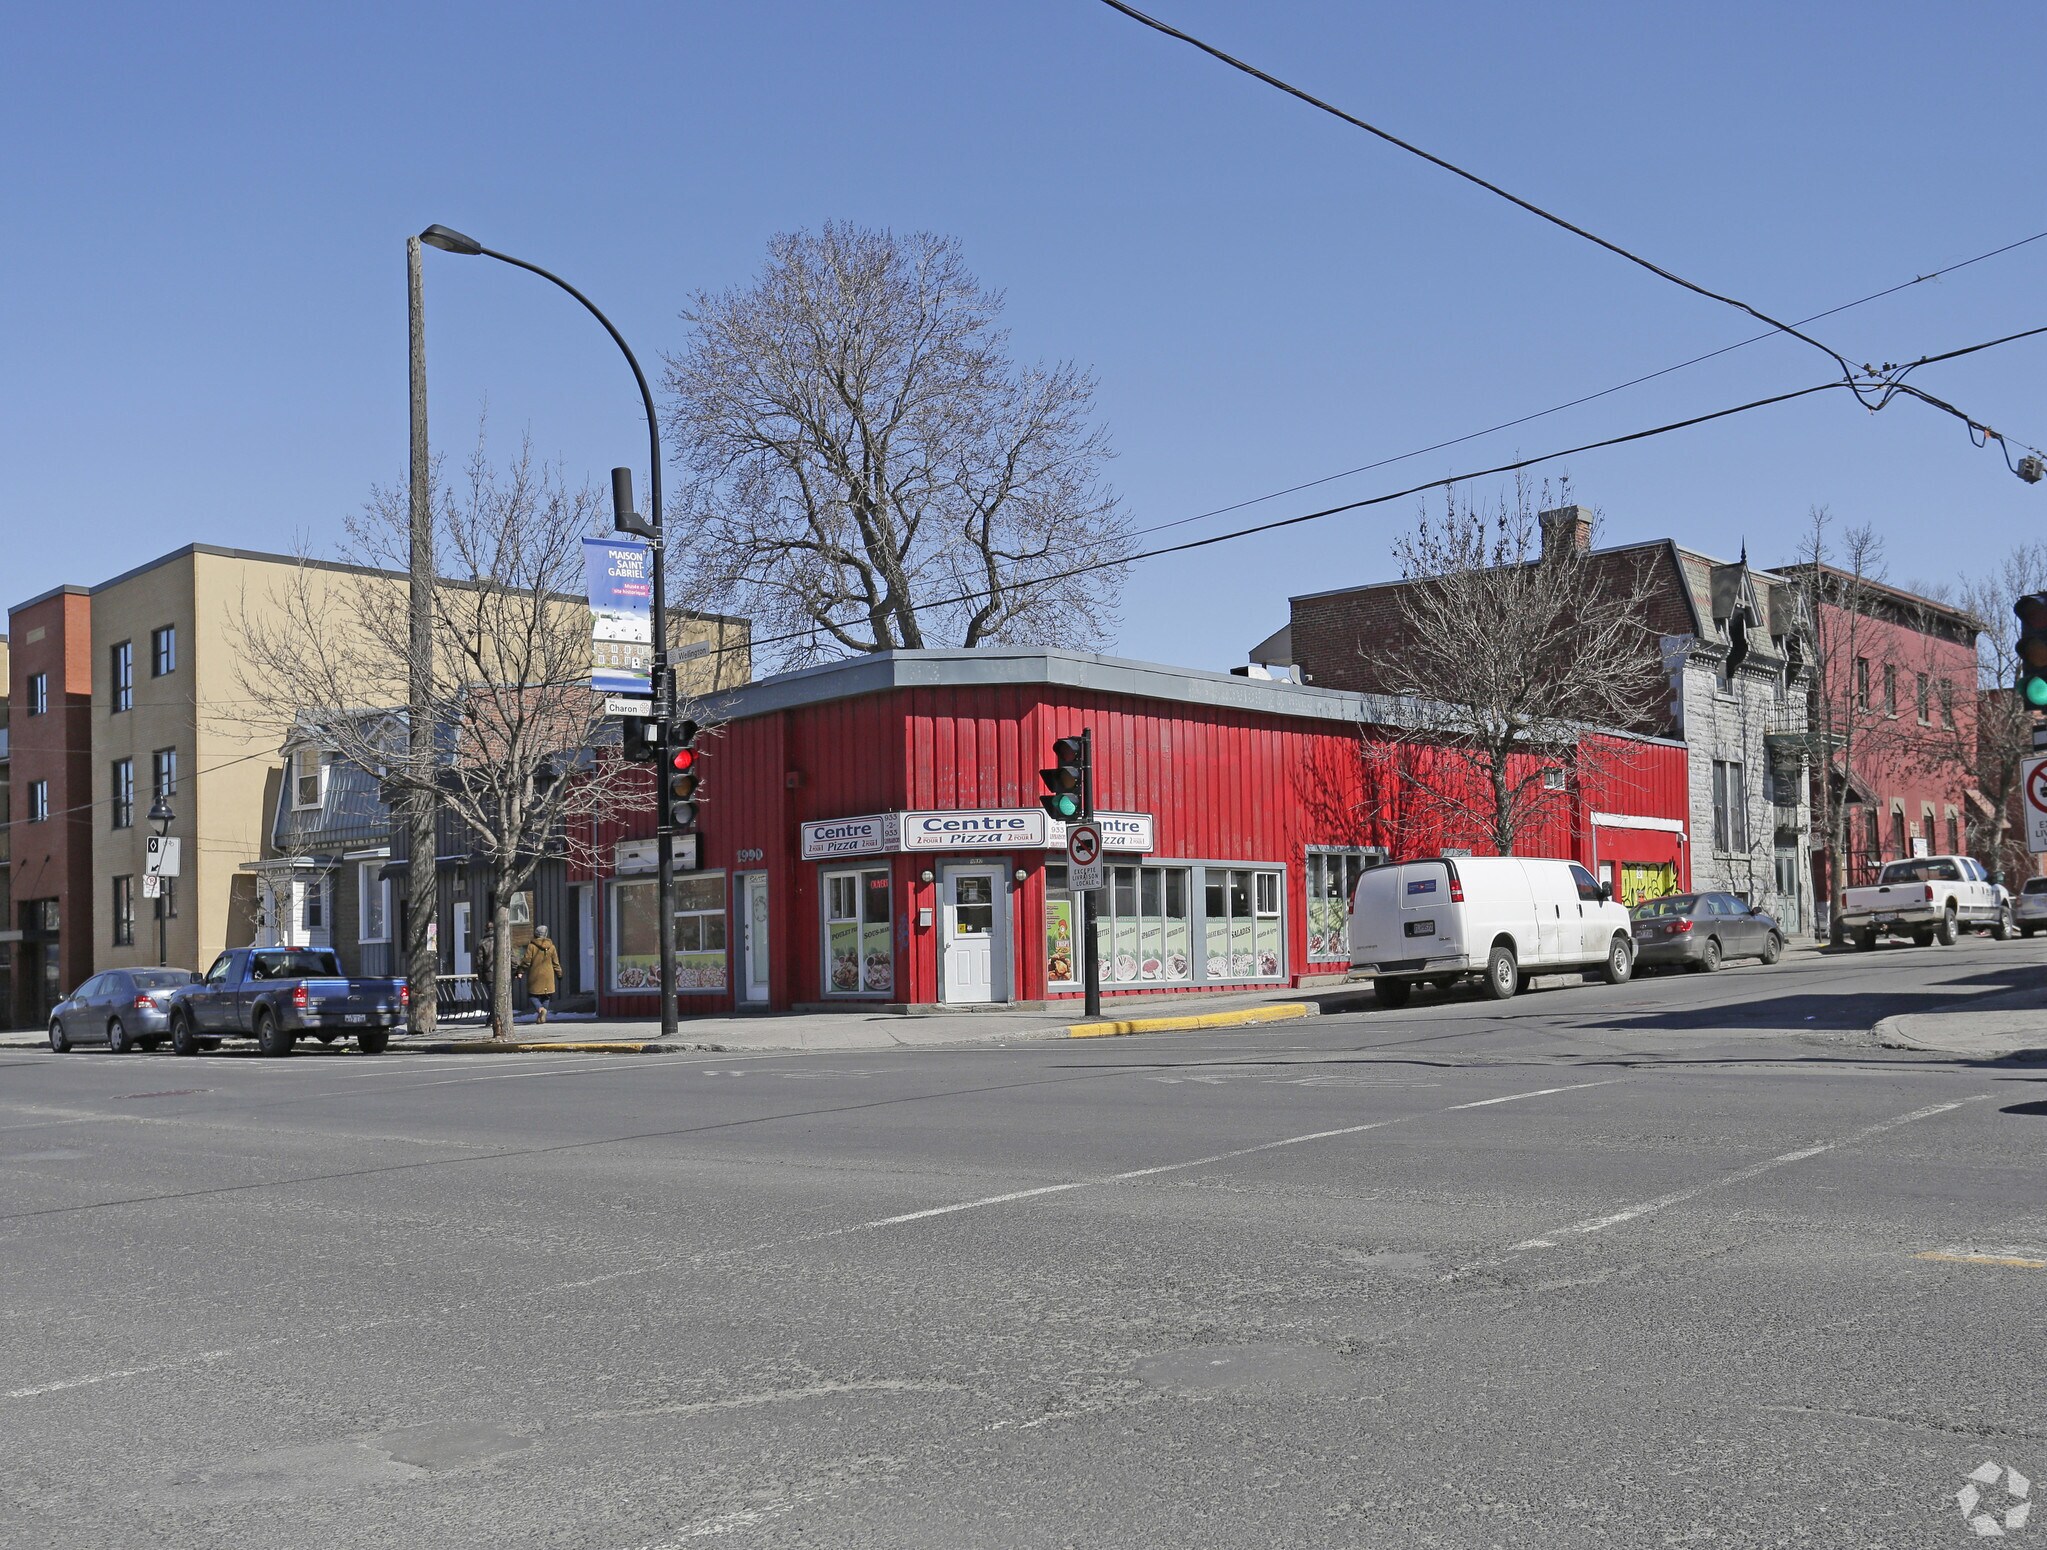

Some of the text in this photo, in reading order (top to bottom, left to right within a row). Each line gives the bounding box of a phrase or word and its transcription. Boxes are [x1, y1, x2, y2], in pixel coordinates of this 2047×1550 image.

[608, 550, 643, 561] MAISON
[617, 560, 645, 570] SAINT-
[608, 567, 645, 579] GABRIEL
[678, 647, 707, 661] Wellington
[609, 703, 638, 713] Charon
[922, 817, 1025, 831] Centre
[1103, 819, 1140, 832] ntre
[813, 824, 872, 840] Centre
[949, 833, 1003, 844] Pizza
[827, 840, 858, 851] Pizza
